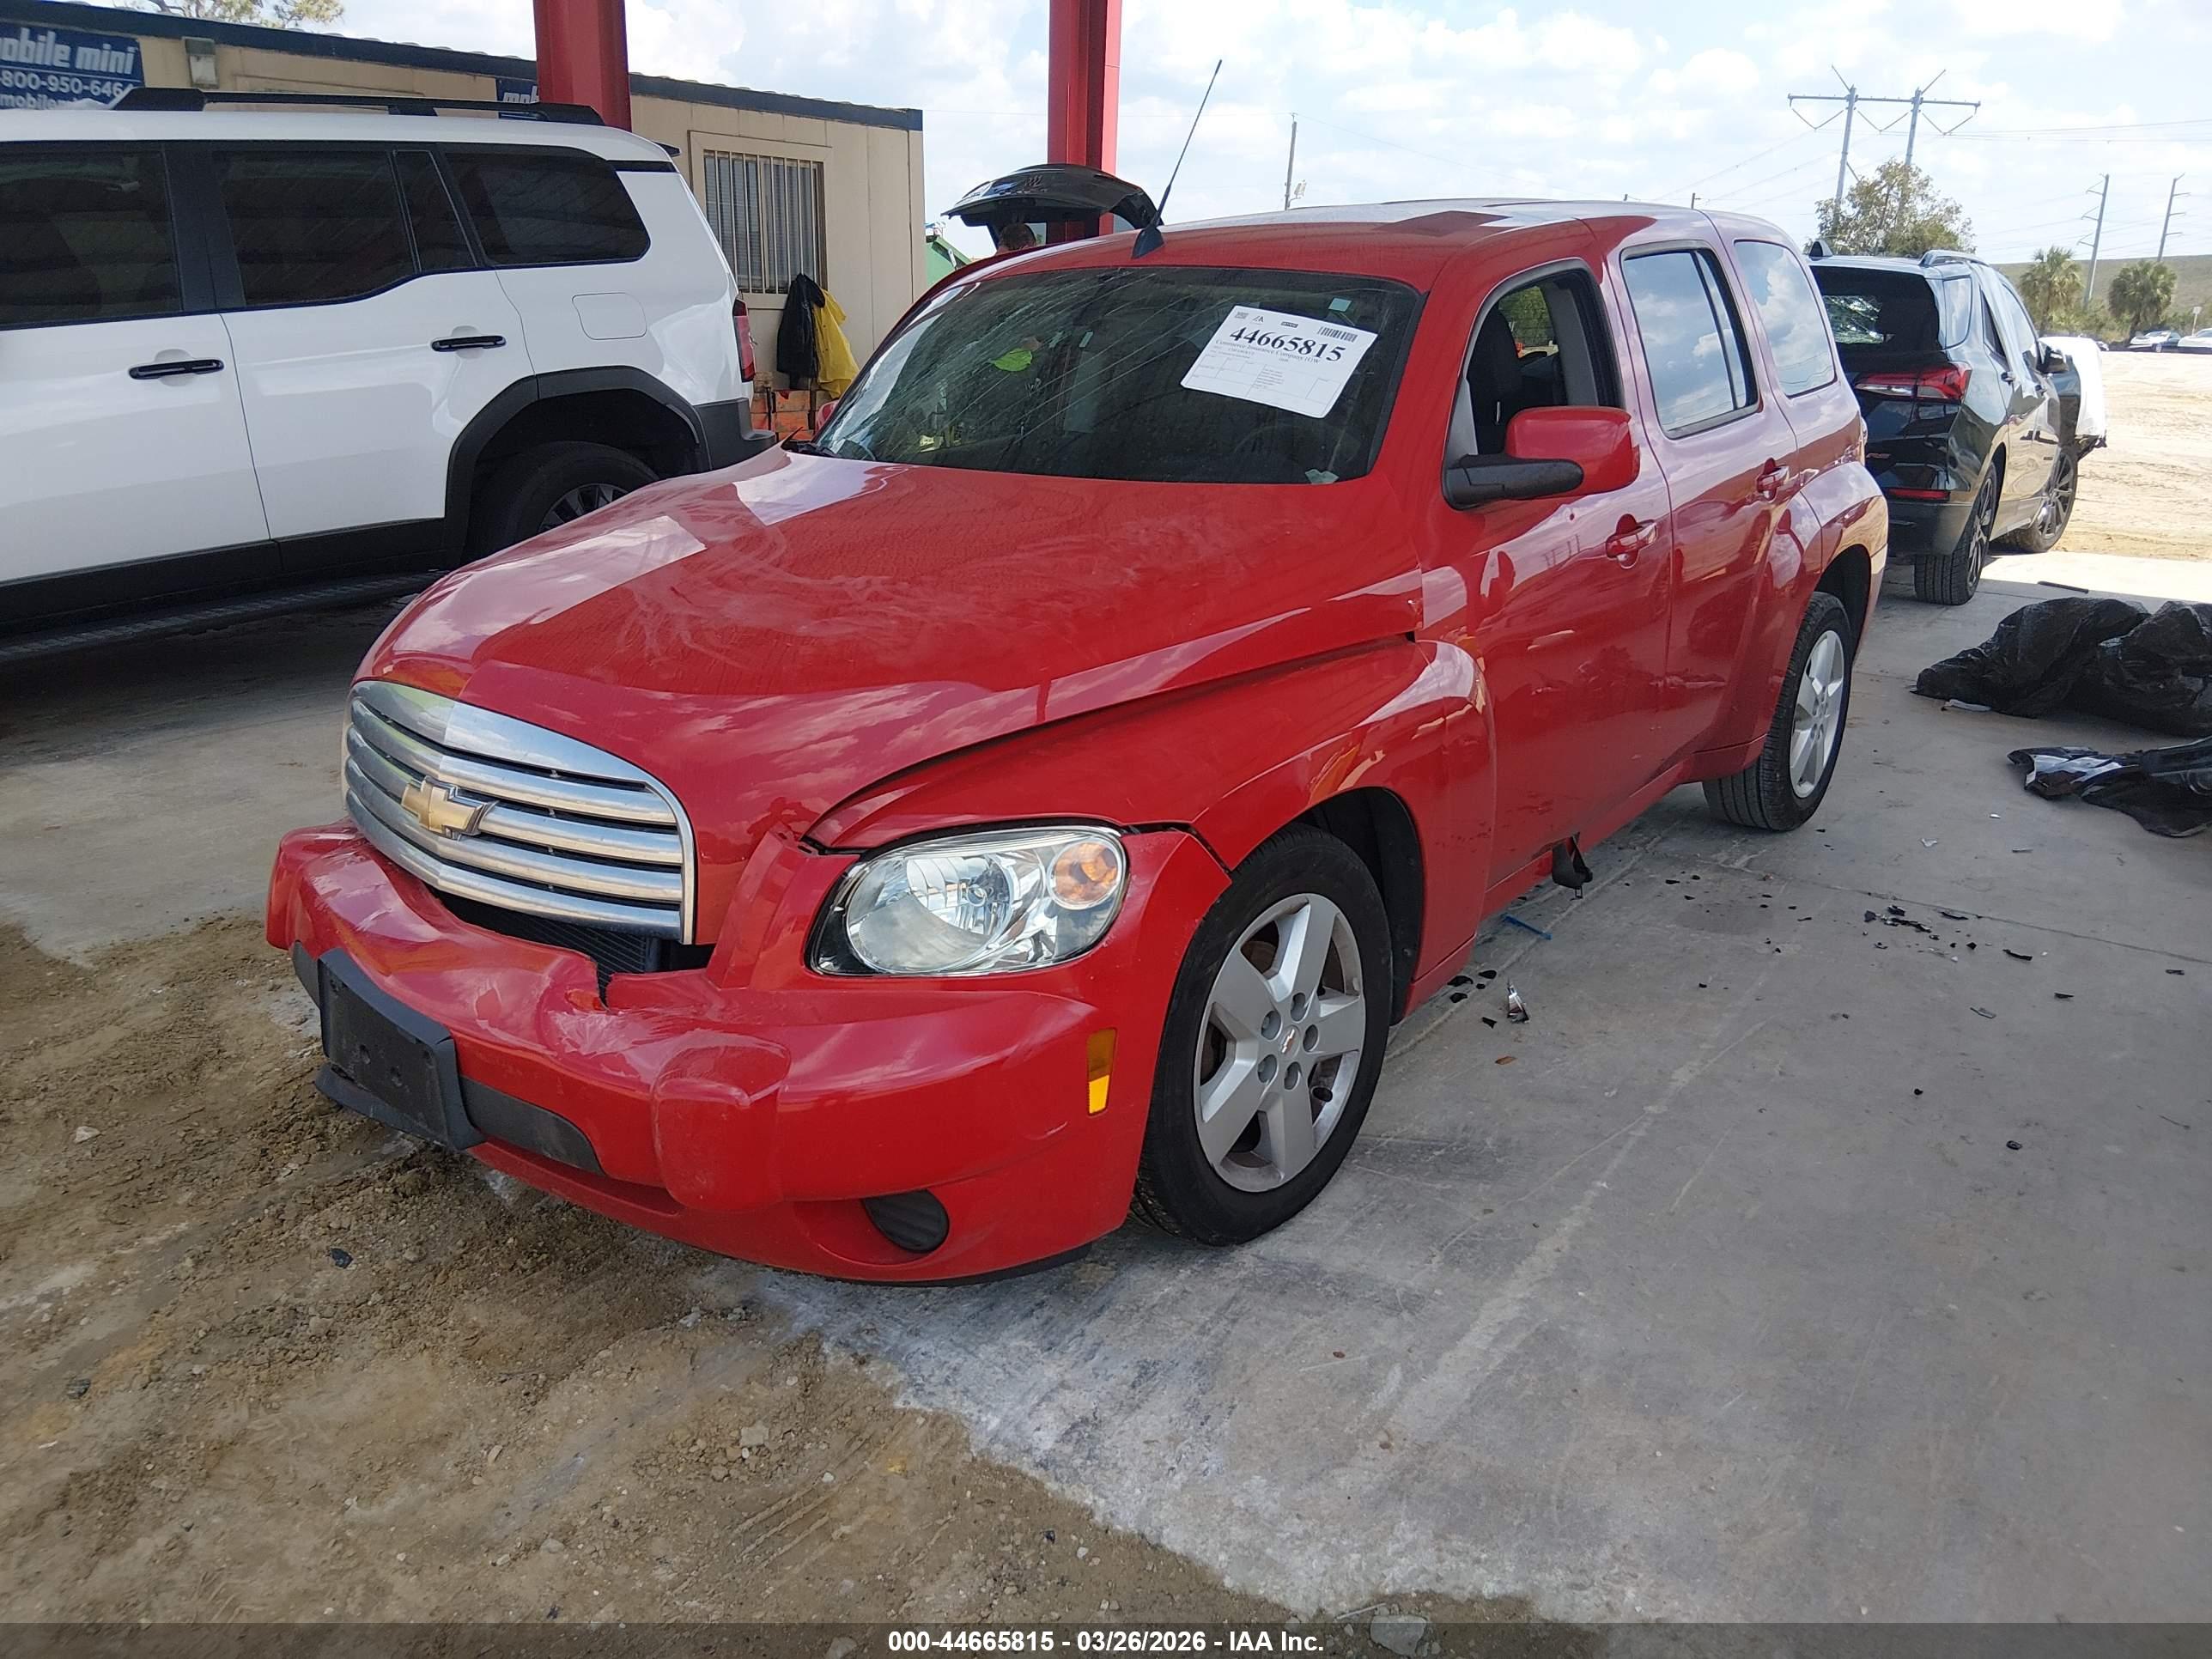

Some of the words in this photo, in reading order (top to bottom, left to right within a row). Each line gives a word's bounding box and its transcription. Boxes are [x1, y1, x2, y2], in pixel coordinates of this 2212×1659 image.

[0, 27, 71, 69] obile
[75, 43, 136, 75] mini
[1229, 326, 1346, 362] 44665815
[1275, 349, 1304, 360] Company
